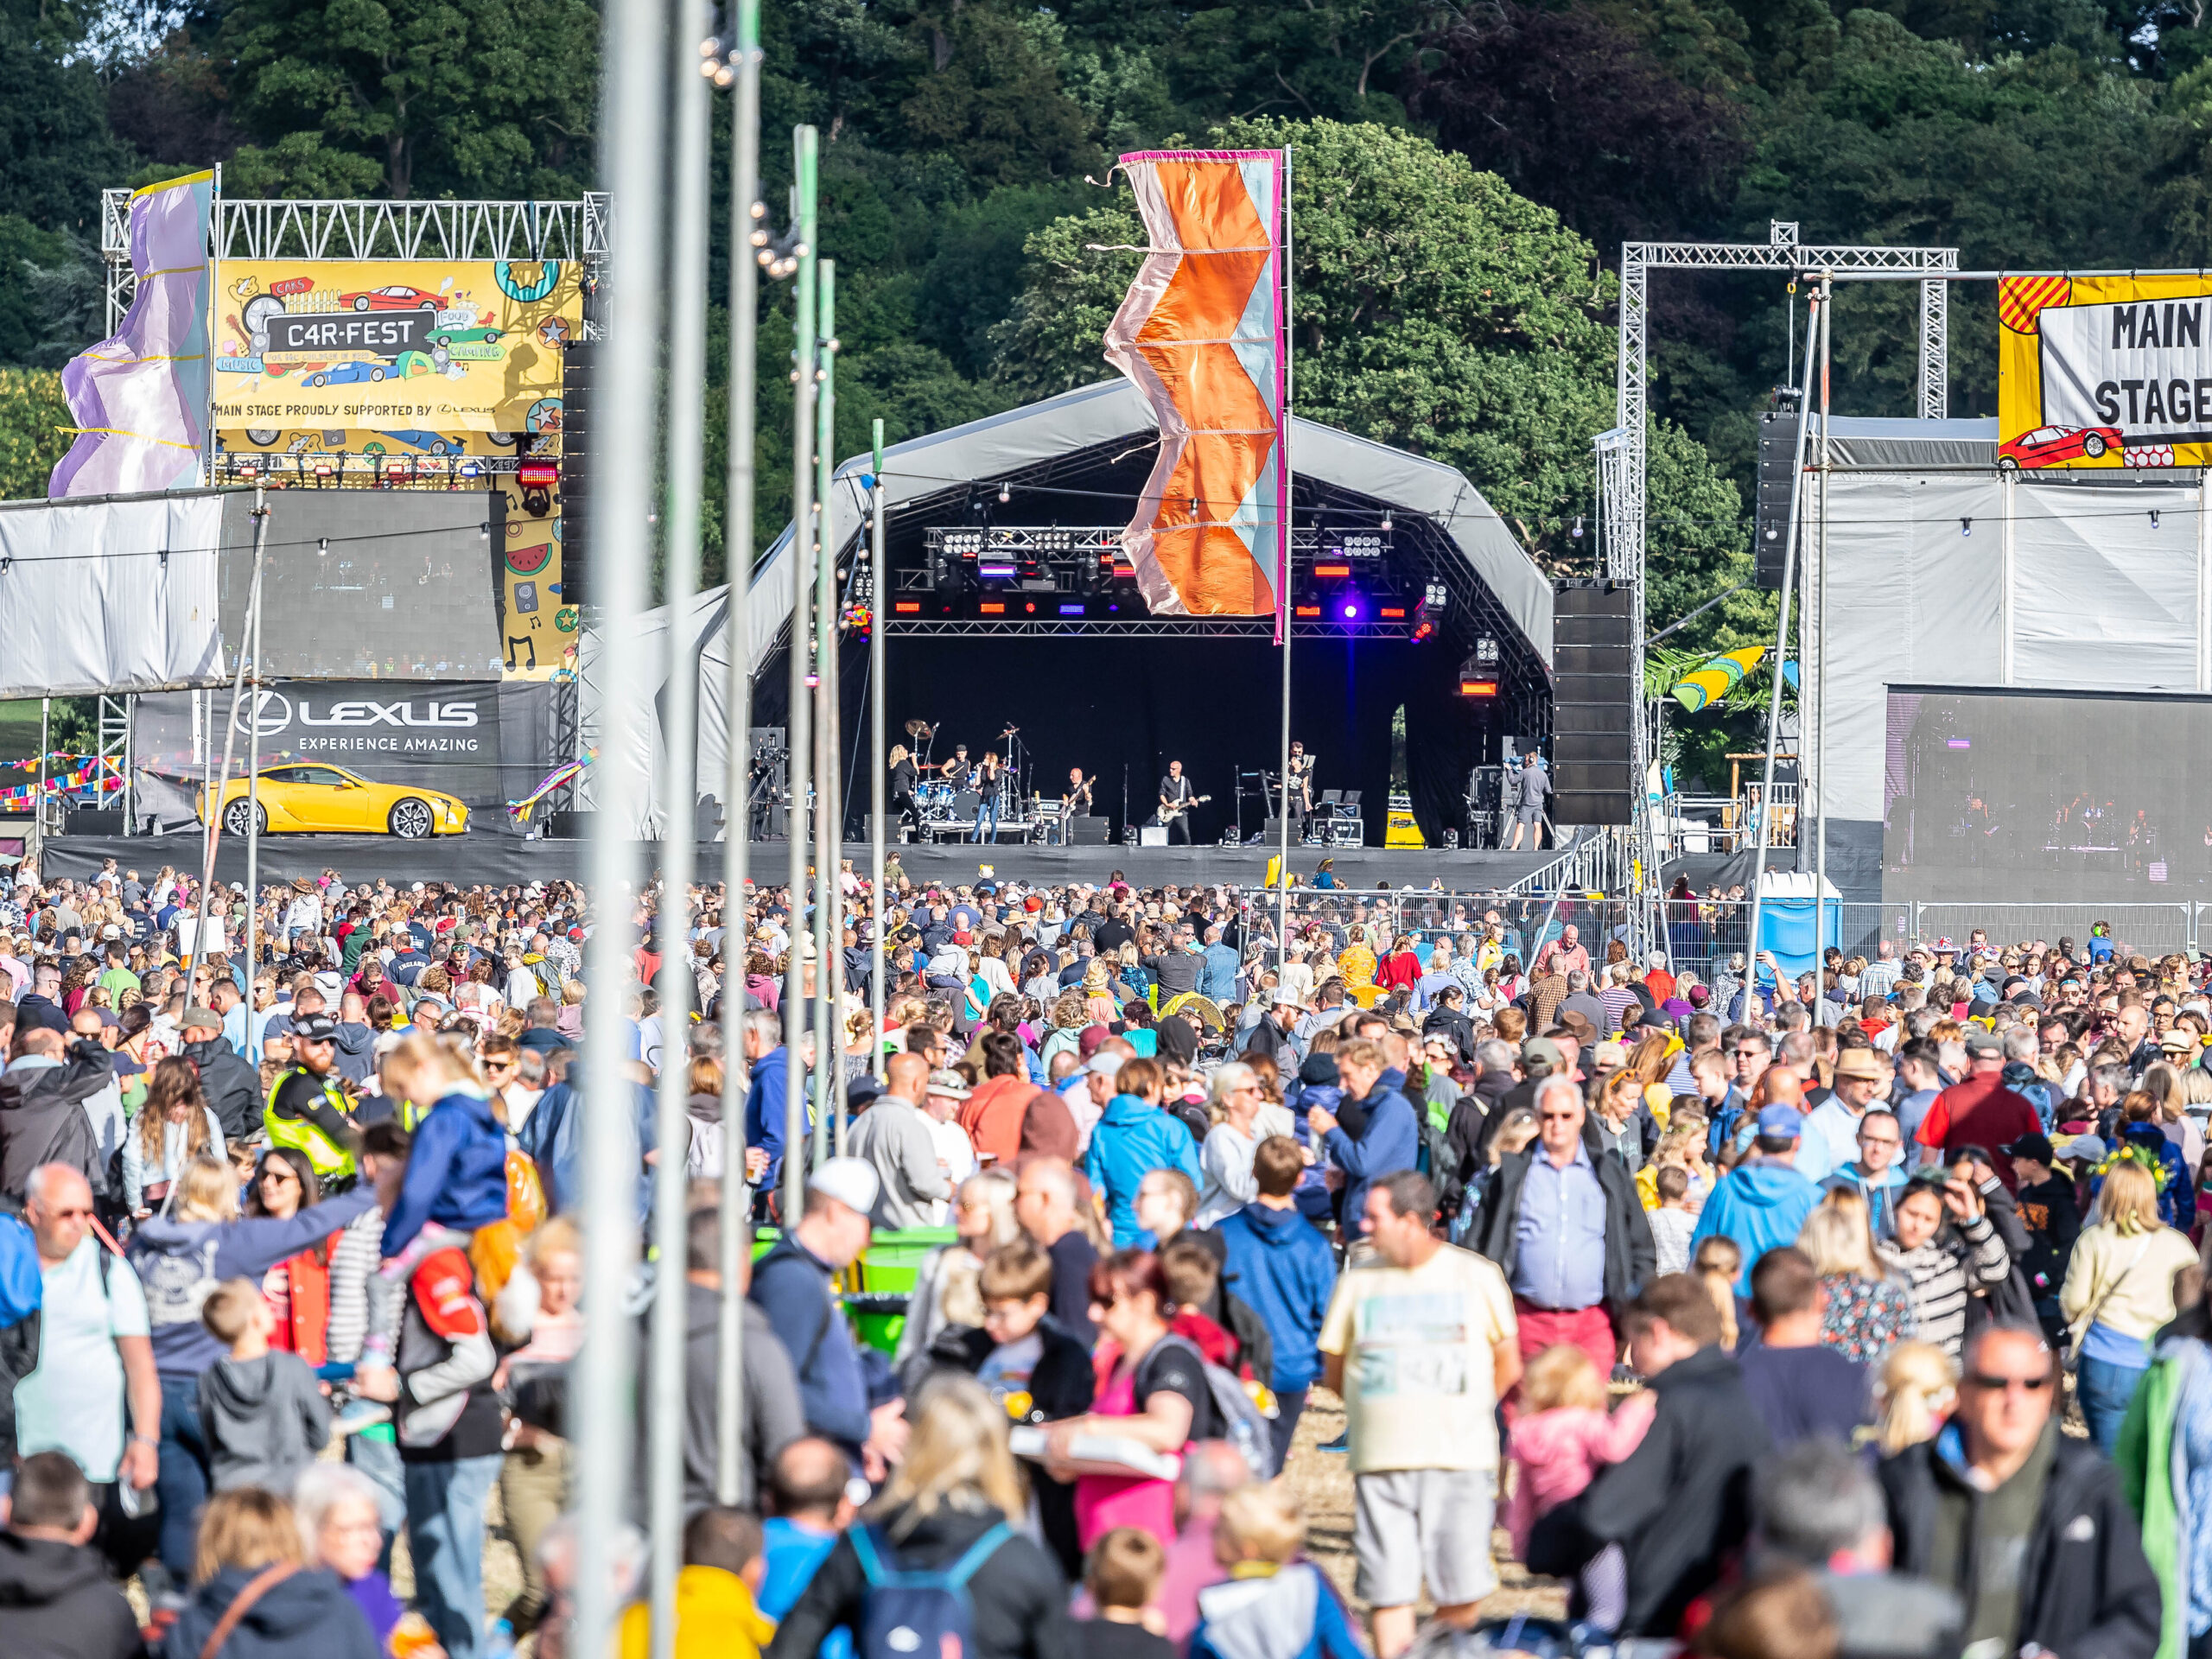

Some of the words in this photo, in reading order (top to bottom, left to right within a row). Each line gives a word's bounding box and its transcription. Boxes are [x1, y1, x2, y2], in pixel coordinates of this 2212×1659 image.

[276, 279, 305, 295] CARS
[440, 310, 469, 323] FOOD
[2112, 303, 2202, 349] MAIN
[450, 345, 499, 358] CAMPING
[221, 358, 258, 371] MUSIC
[2094, 378, 2212, 425] STAGE
[216, 404, 242, 416] MAIN
[246, 404, 282, 416] STAGE
[286, 404, 339, 416] PROUDLY
[344, 404, 413, 416] SUPPORTED
[417, 405, 432, 416] BY
[299, 702, 479, 727] LEXUS
[299, 737, 397, 751] EXPERIENCE
[404, 738, 479, 752] AMAZING
